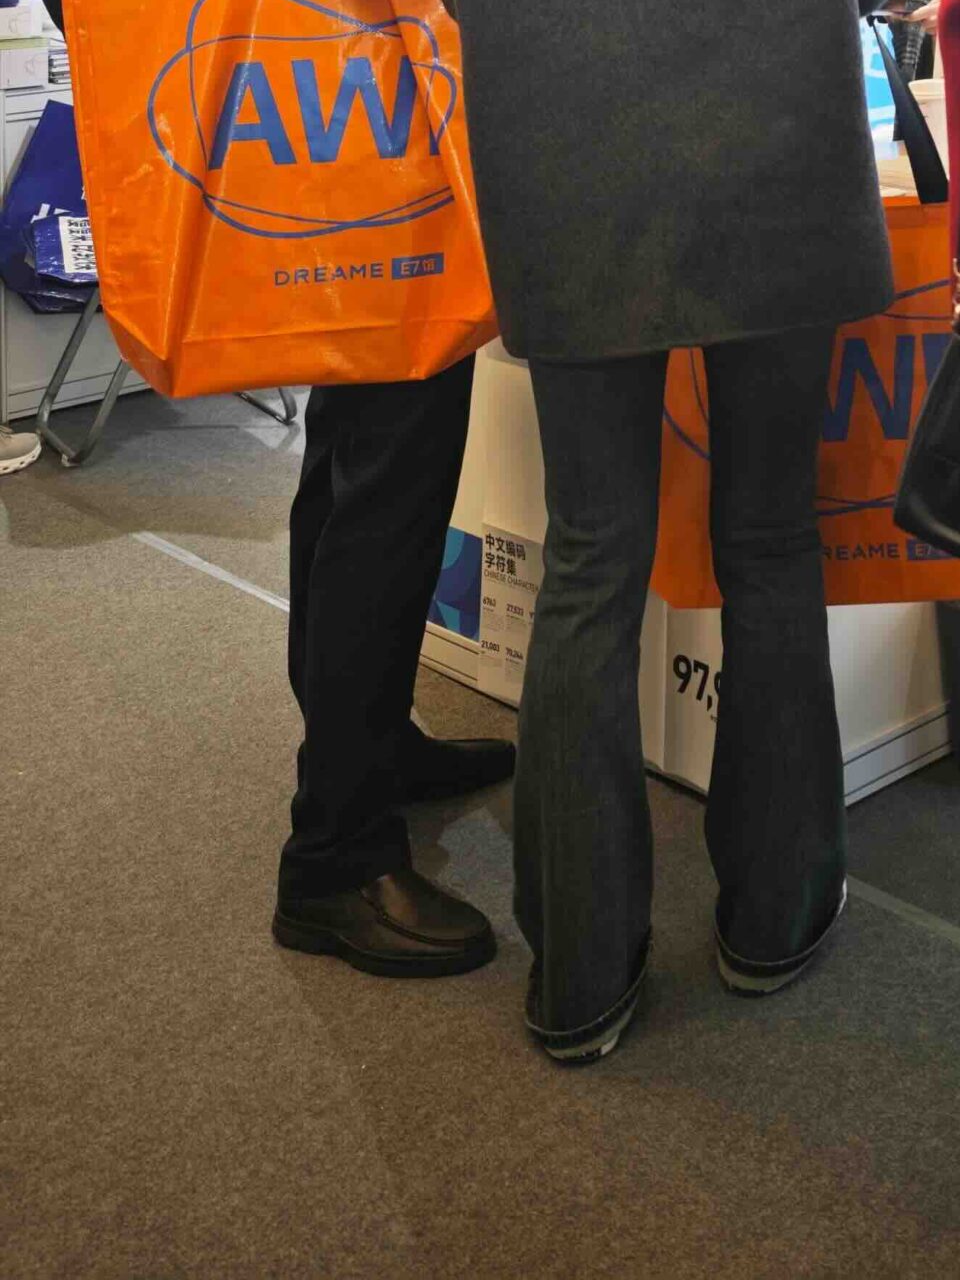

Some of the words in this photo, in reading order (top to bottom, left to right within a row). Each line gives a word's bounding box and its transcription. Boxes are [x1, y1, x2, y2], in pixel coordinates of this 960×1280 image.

[208, 56, 441, 170] AW
[274, 262, 384, 287] DREAME
[485, 533, 526, 561] 中文编码
[485, 552, 517, 577] 字符集
